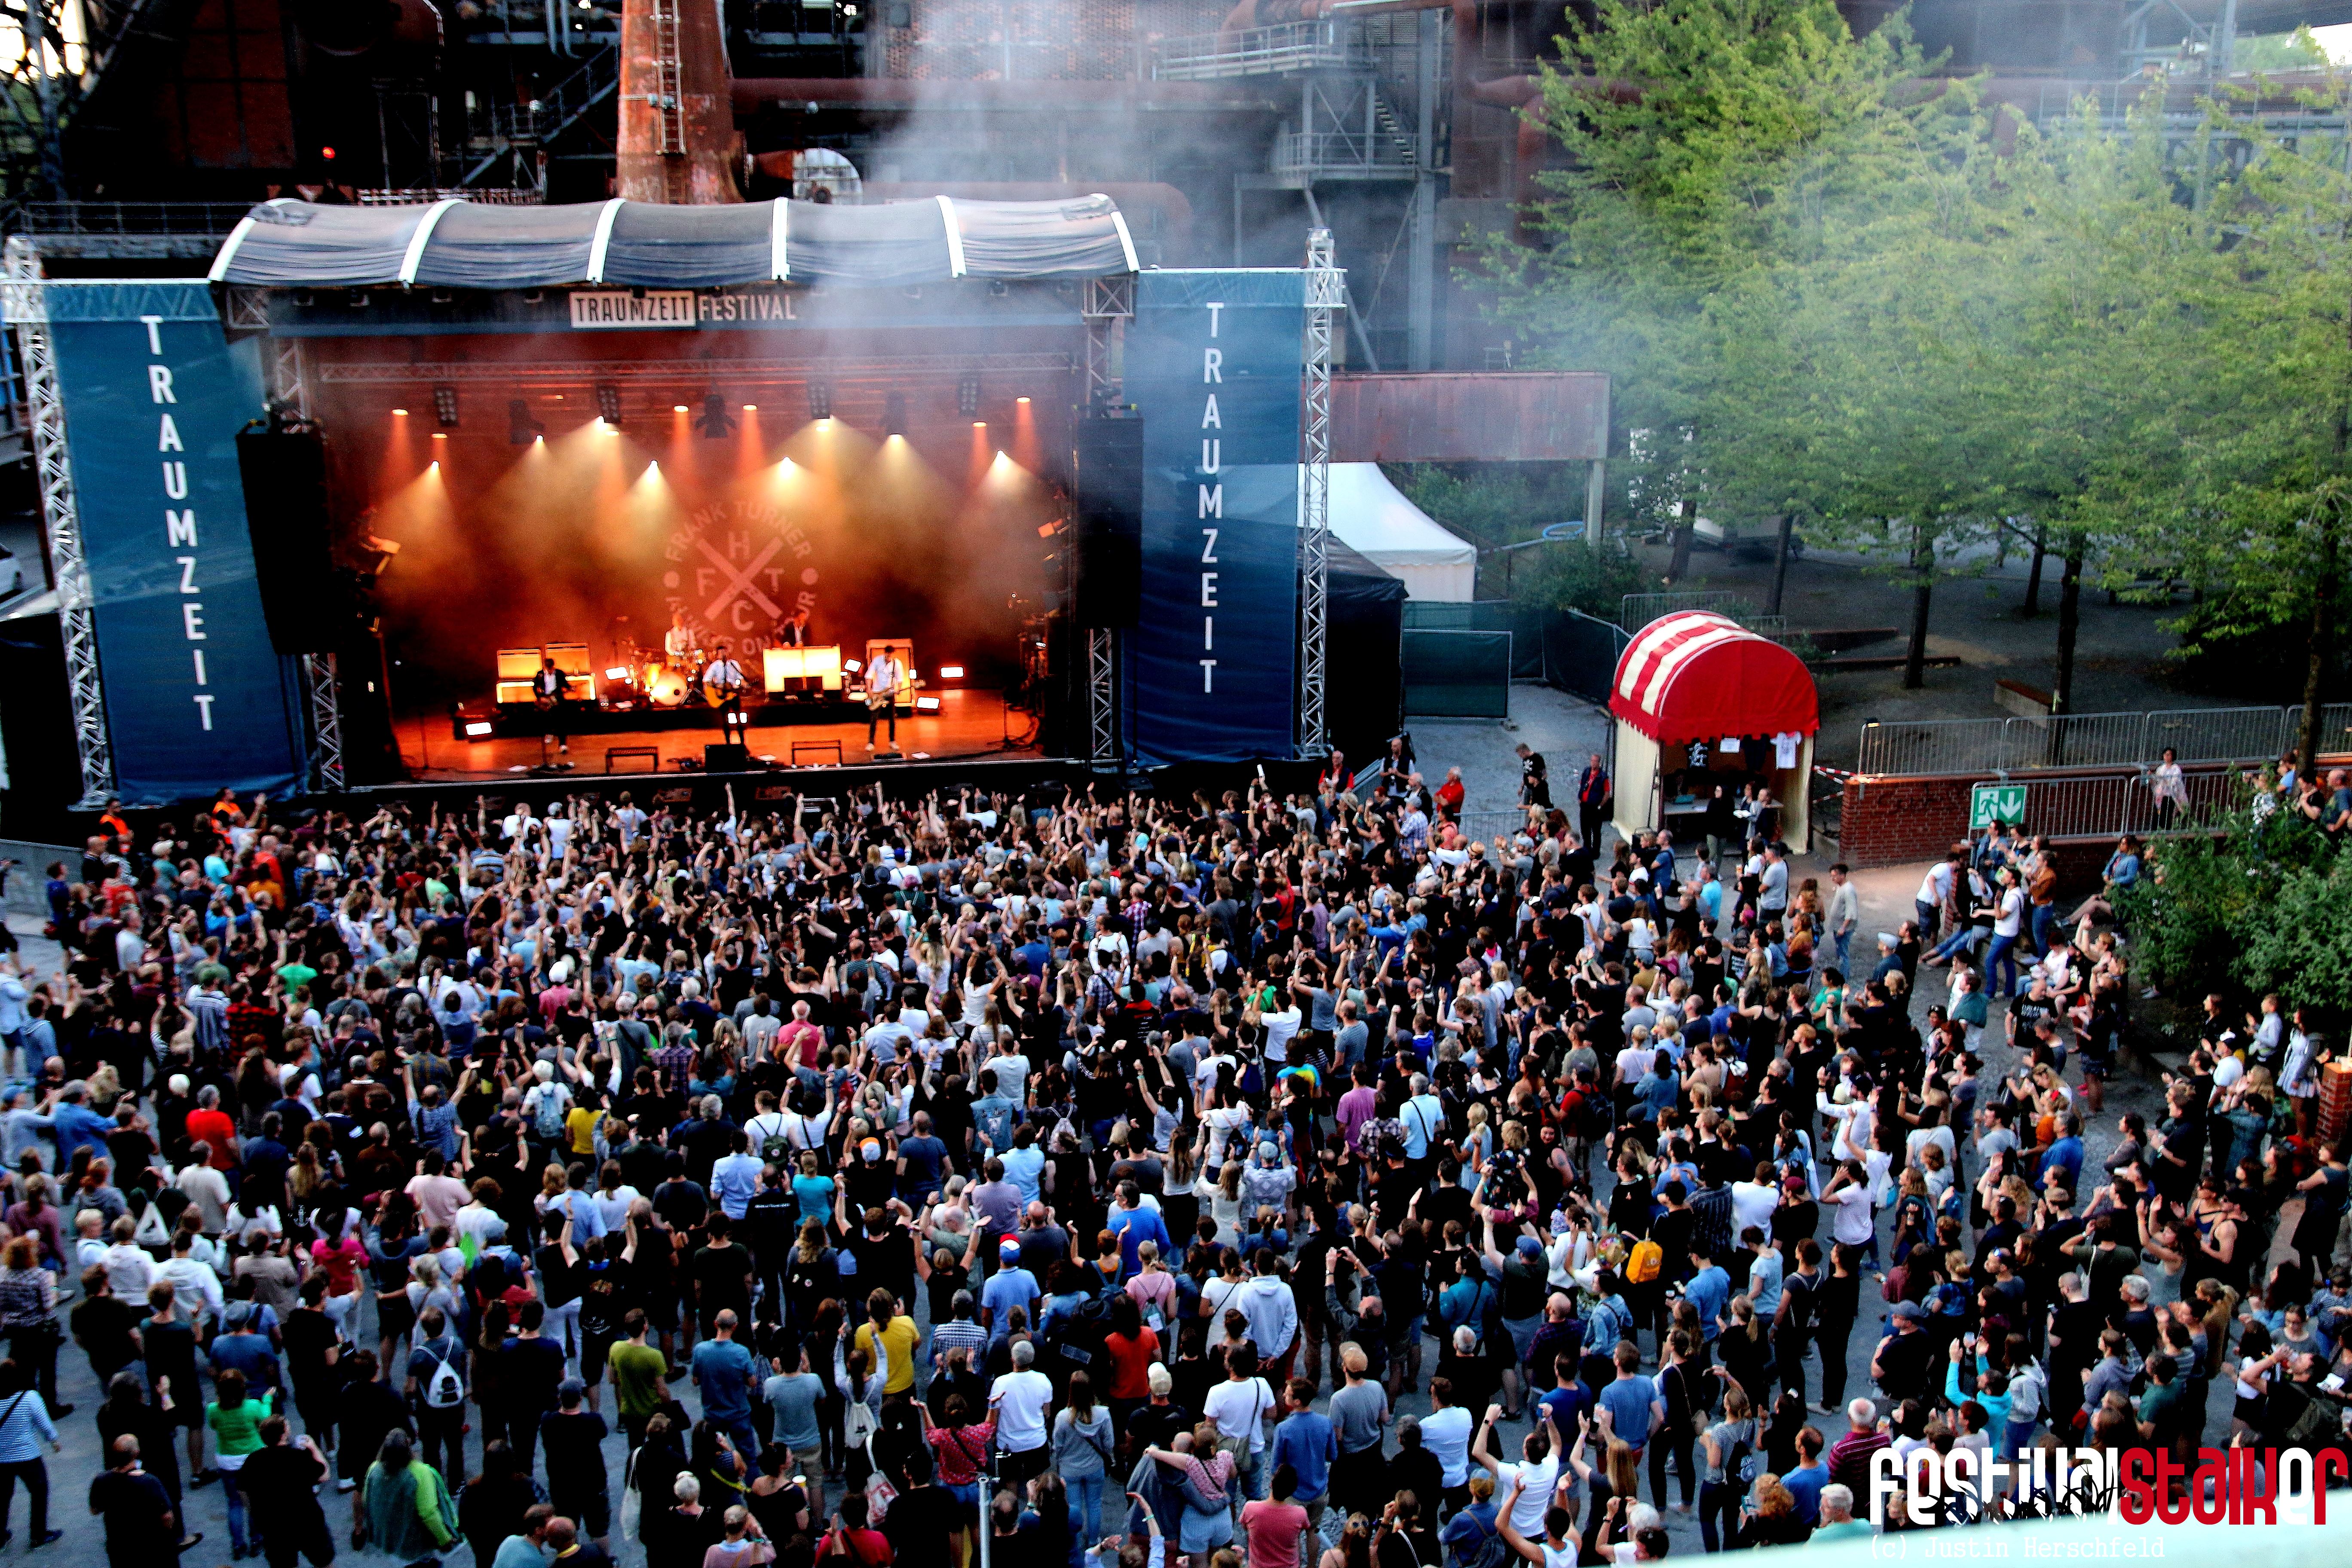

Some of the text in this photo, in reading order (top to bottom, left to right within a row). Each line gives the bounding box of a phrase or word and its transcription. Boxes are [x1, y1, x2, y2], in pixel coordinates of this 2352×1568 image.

[576, 295, 797, 322] TRAUMZEIT FESTIVAL
[140, 315, 215, 731] TRAUMZEIT
[665, 500, 812, 562] FRANK TURNER
[1198, 302, 1225, 694] TRAUMZEIT
